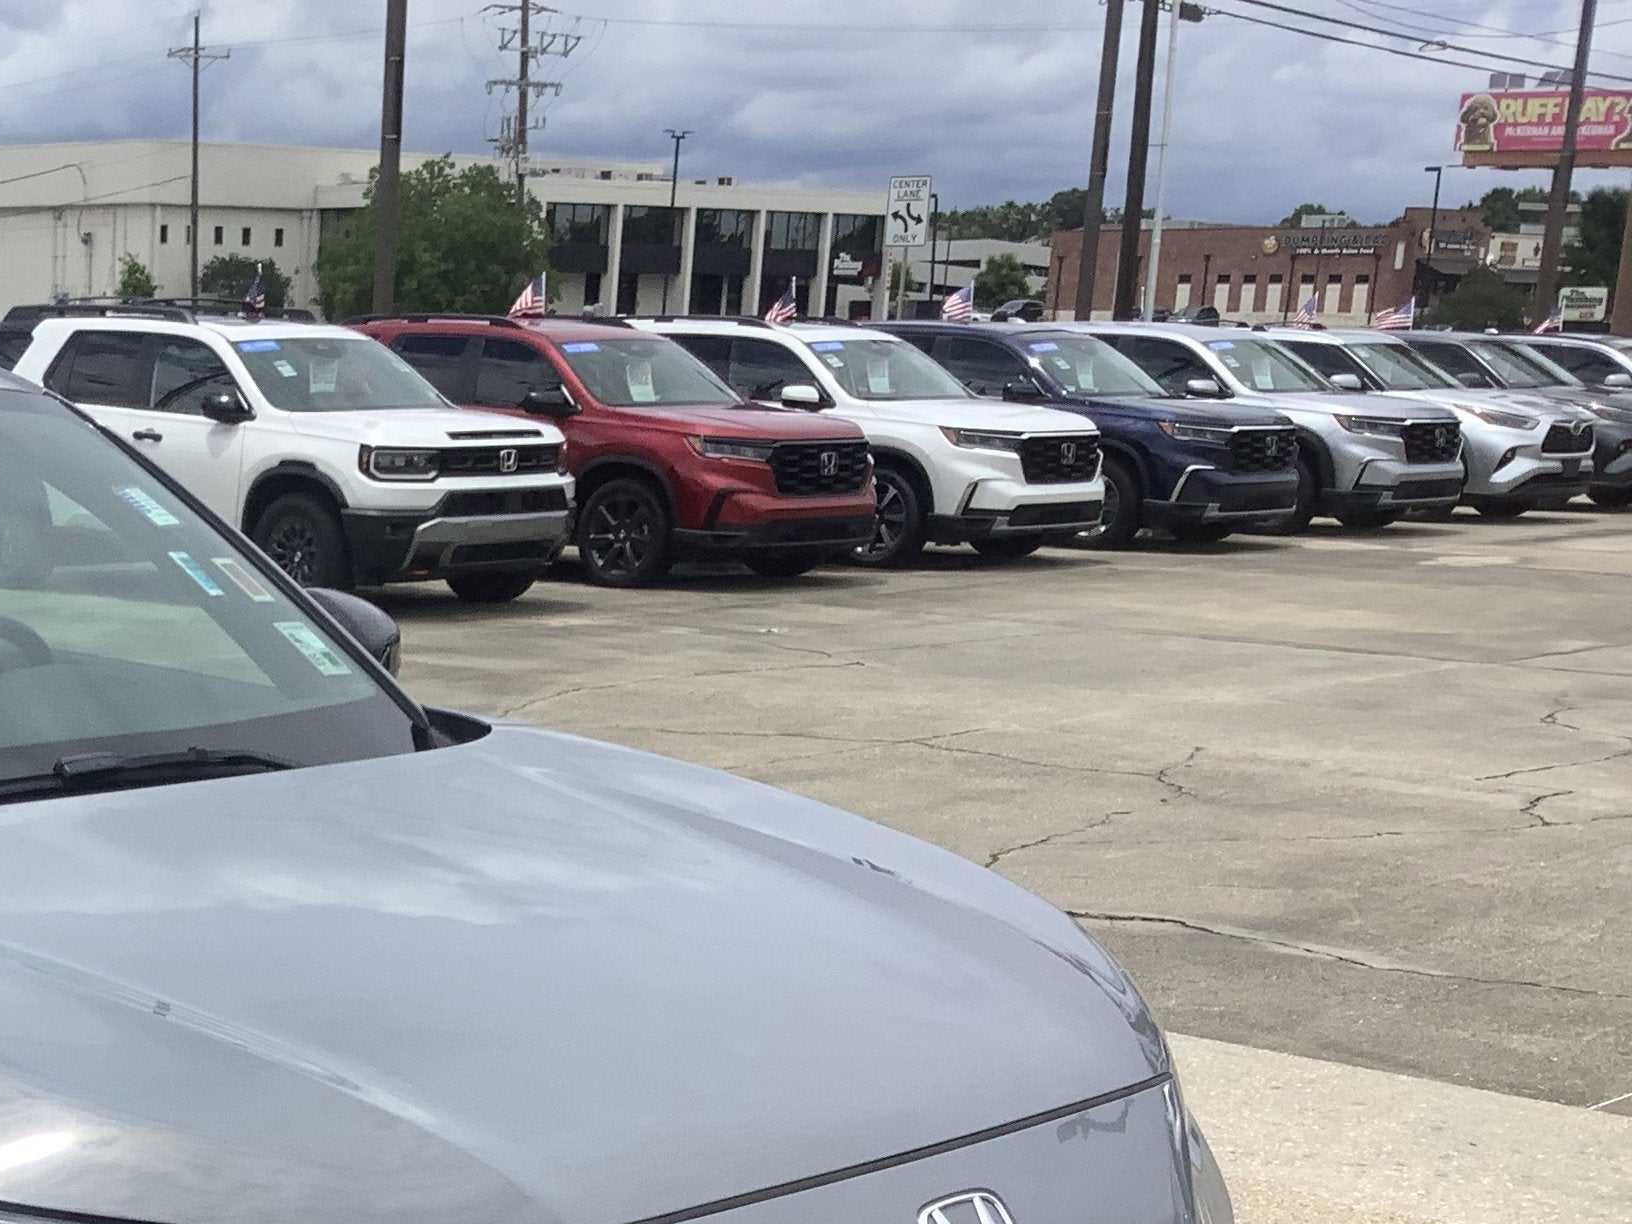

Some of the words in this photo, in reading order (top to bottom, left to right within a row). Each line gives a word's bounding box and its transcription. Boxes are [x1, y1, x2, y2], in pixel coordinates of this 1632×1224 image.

[1499, 97, 1563, 123] RUFF
[1561, 96, 1628, 122] AY?
[893, 179, 928, 189] CENTER
[896, 189, 922, 199] LANE
[892, 234, 918, 244] ONLY
